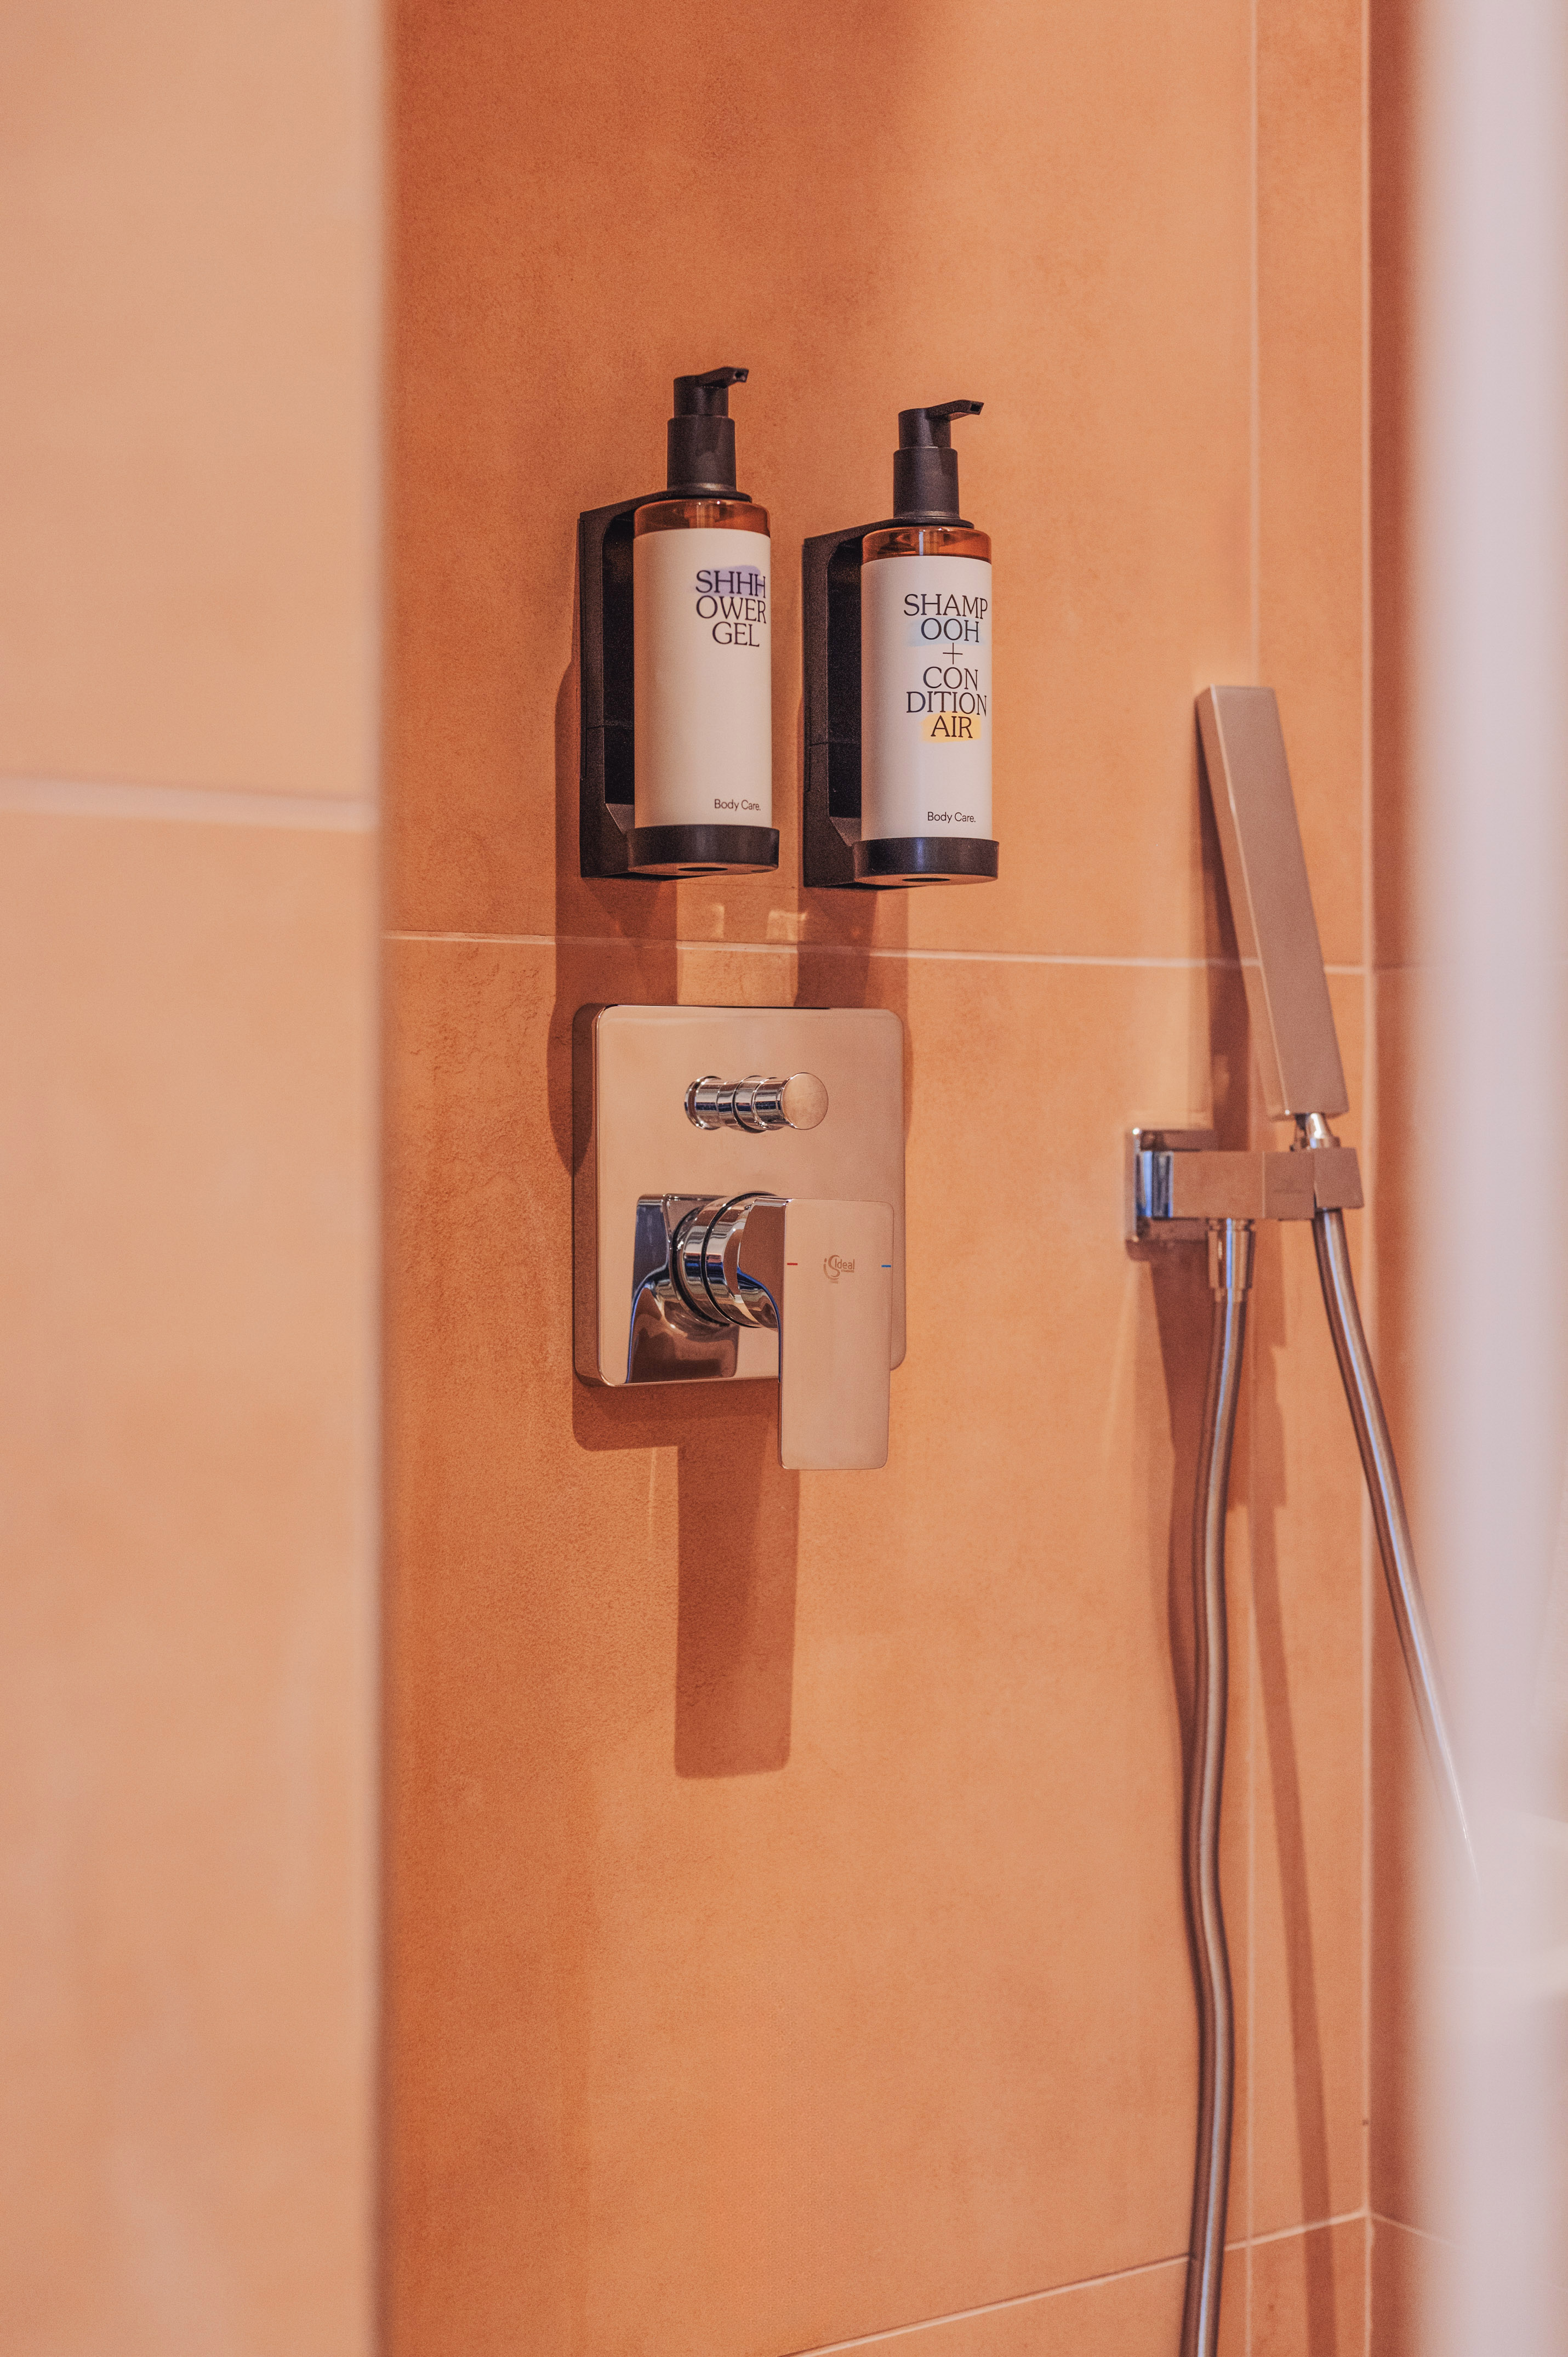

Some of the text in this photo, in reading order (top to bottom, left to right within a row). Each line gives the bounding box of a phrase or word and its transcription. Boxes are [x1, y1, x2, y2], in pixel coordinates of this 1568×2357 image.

[695, 570, 766, 599] SHHH
[696, 595, 766, 624] OWER
[904, 594, 988, 619] SHAMP
[712, 621, 760, 647] GEL
[921, 618, 979, 642] OOH
[923, 667, 978, 691] CON
[906, 691, 987, 717] DITION
[931, 715, 973, 738] AIR
[714, 799, 761, 811] Body Care.
[928, 811, 976, 823] Body Care.
[835, 1258, 855, 1269] Ideal
